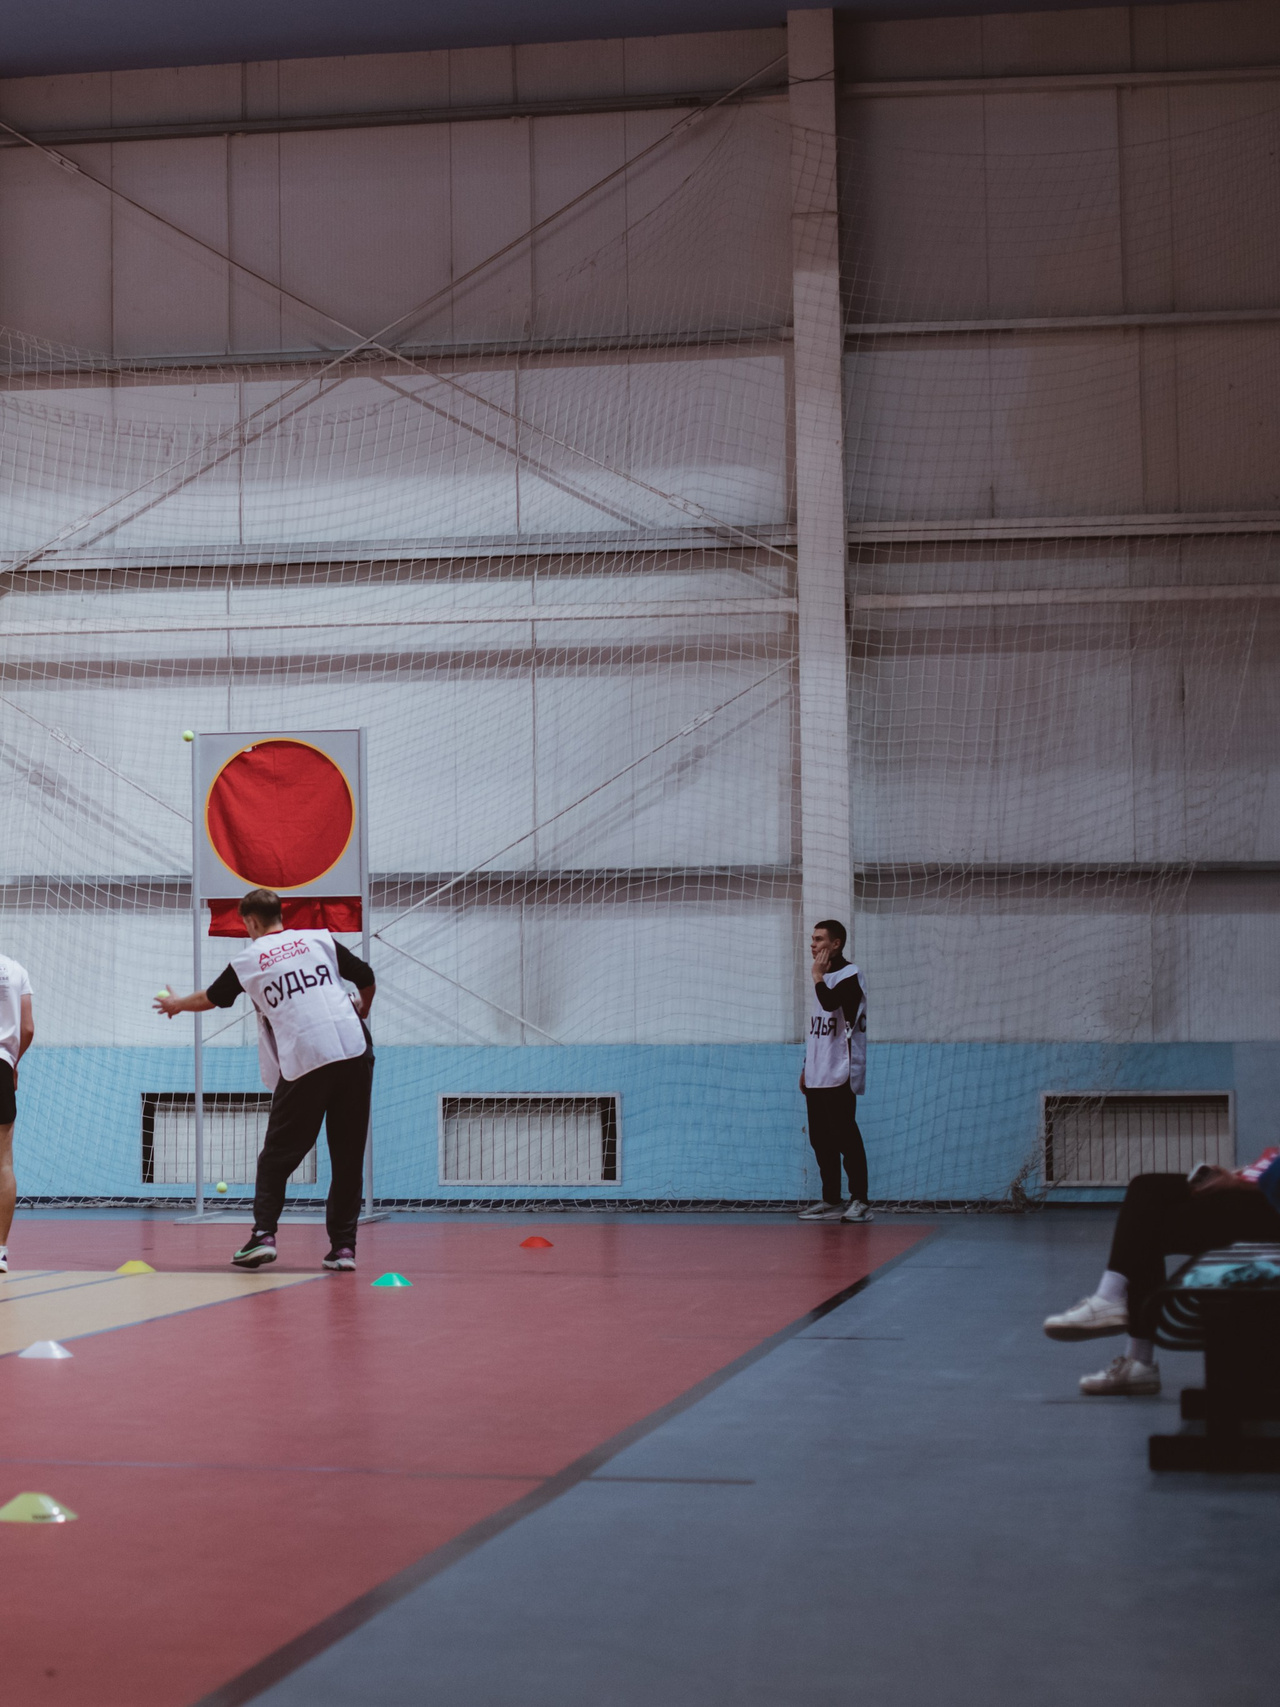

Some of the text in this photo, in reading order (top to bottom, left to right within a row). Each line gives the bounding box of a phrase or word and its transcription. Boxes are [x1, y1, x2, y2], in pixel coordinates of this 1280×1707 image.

[259, 938, 306, 964] АССК
[260, 946, 310, 971] РОССИИ
[263, 964, 333, 1008] СУДЬЯ
[810, 1015, 837, 1039] УДЬЯ
